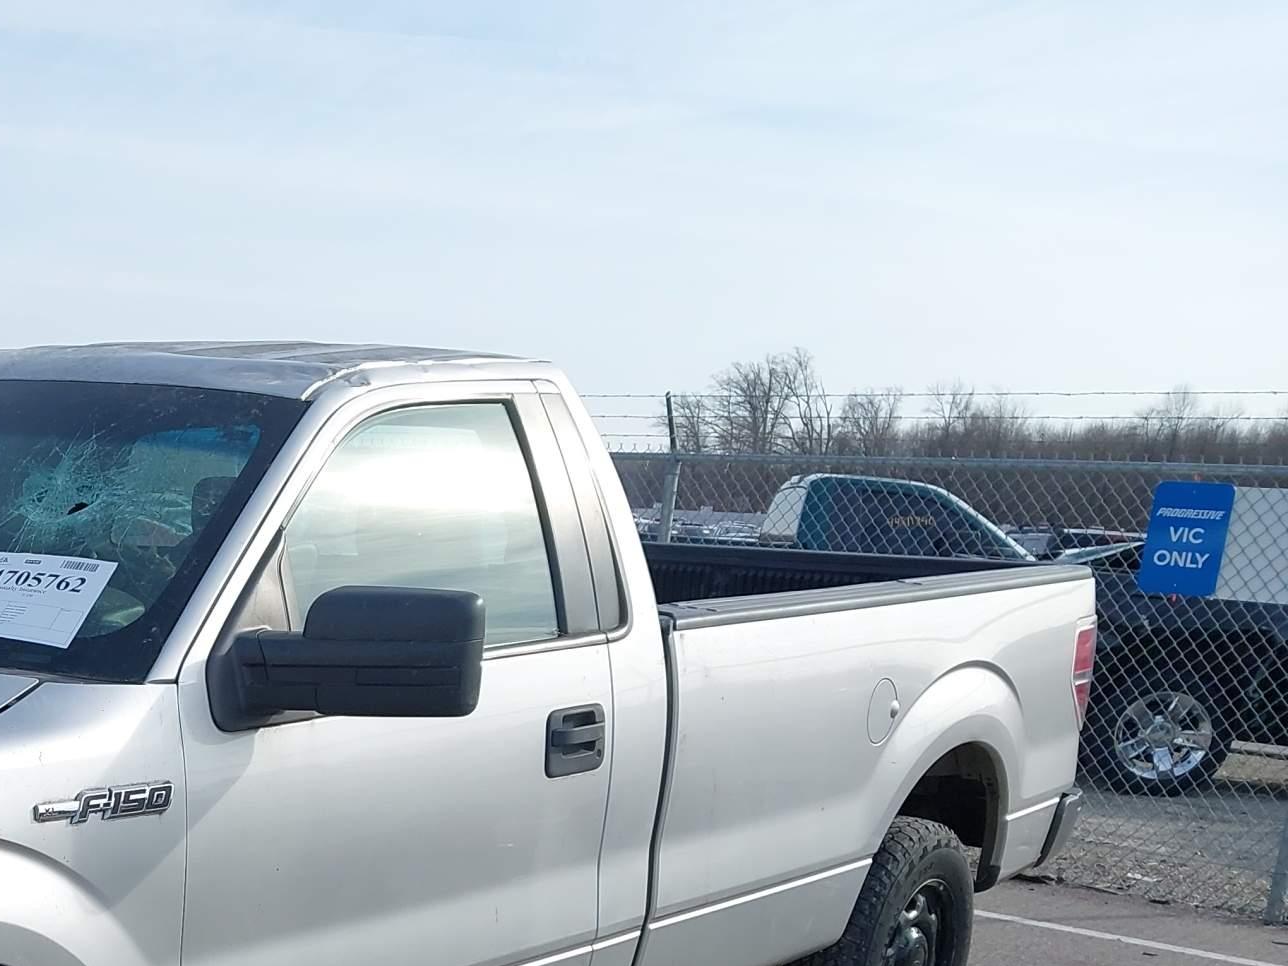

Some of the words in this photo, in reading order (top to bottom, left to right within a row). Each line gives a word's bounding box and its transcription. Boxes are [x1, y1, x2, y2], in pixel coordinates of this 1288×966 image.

[1155, 507, 1226, 520] PROGRESSIVE
[1169, 526, 1205, 544] VIC
[1152, 550, 1210, 569] ONLY
[70, 781, 174, 824] F-150
